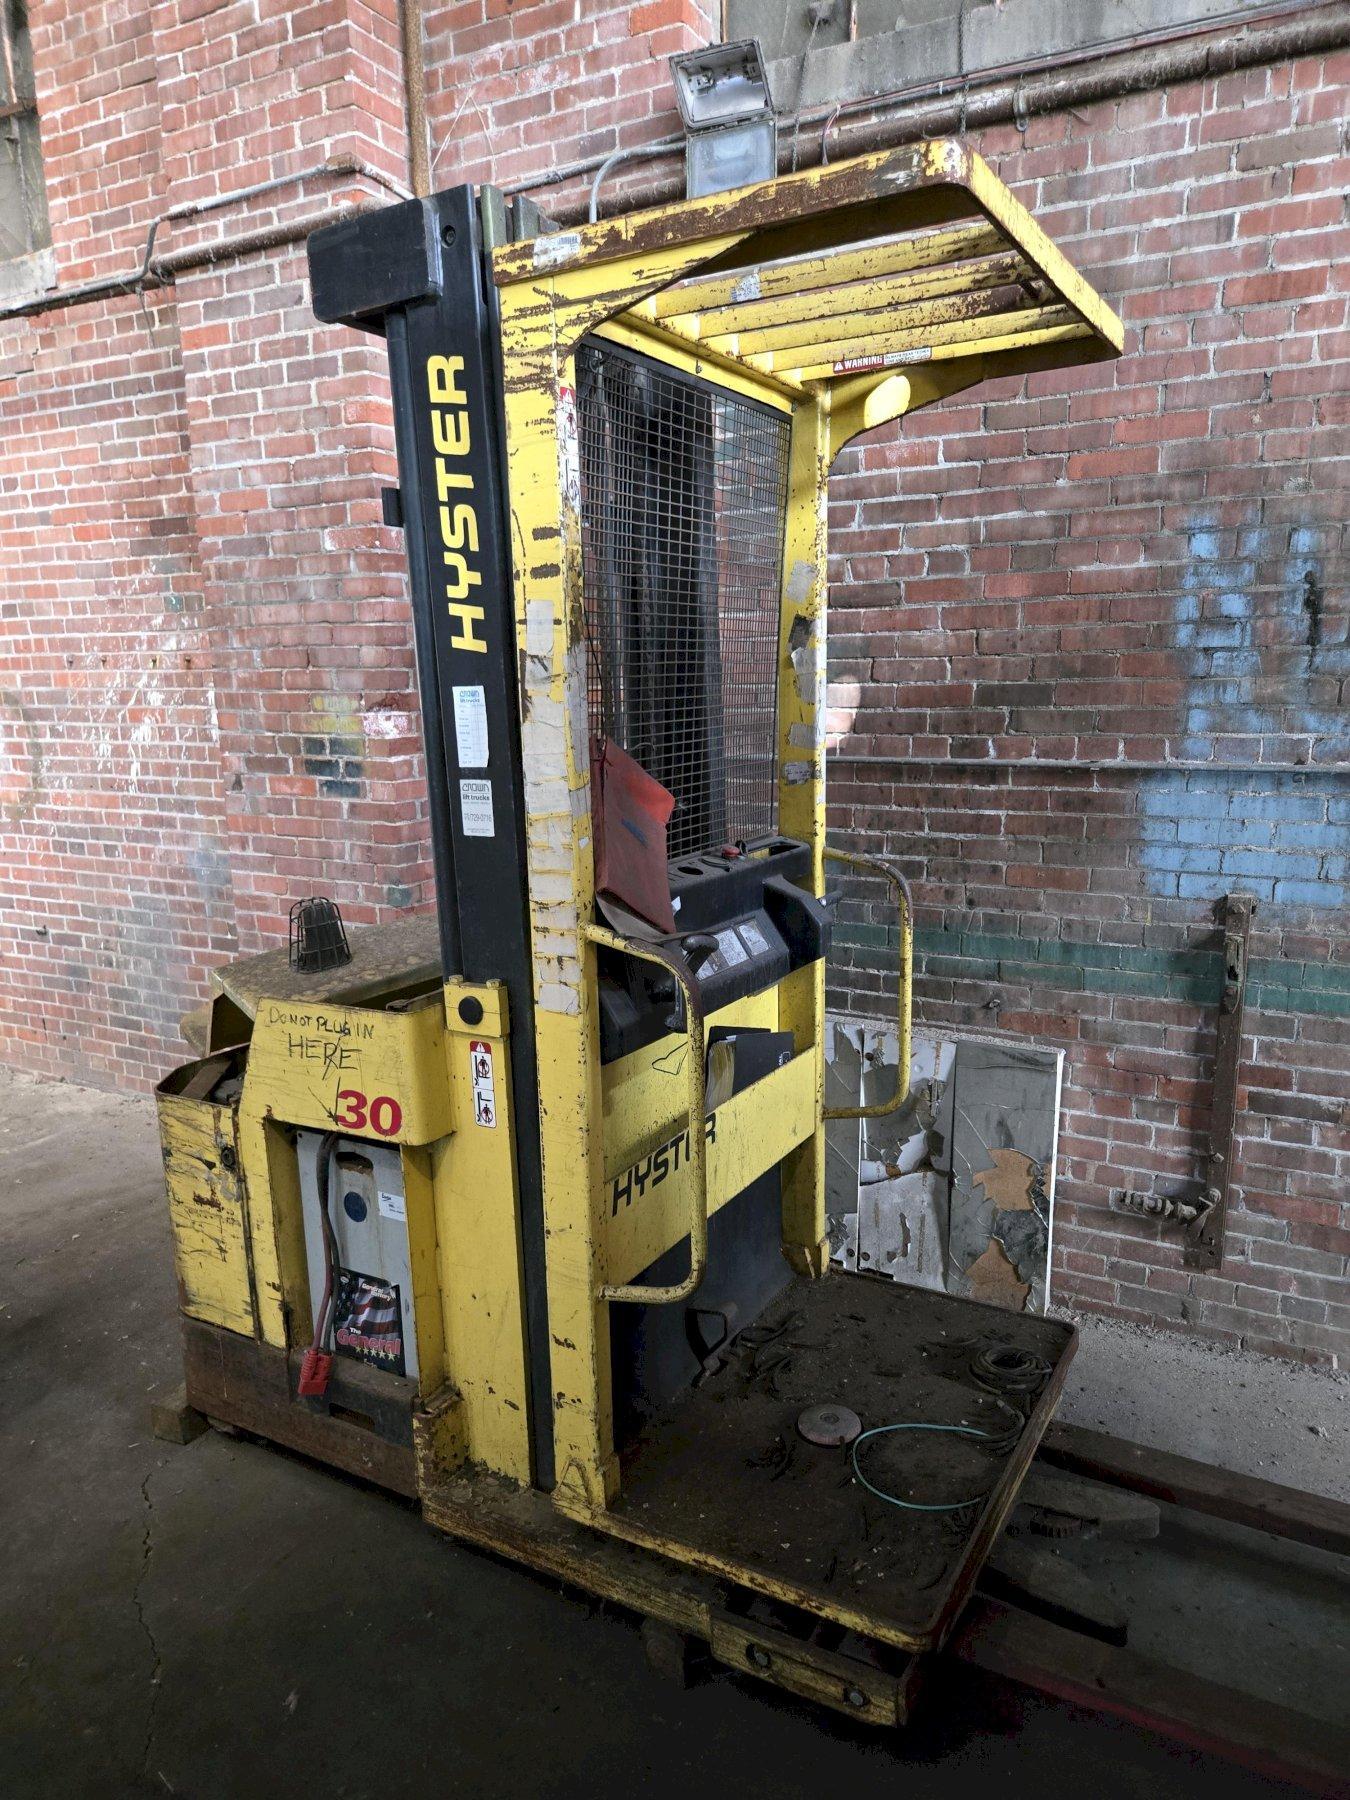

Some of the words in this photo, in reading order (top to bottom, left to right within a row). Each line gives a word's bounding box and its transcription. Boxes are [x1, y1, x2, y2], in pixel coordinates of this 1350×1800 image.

[844, 355, 883, 370] WARNING
[426, 355, 488, 654] HYSTER
[290, 1014, 312, 1027] NOT
[316, 1016, 351, 1037] PLUG
[357, 1023, 375, 1039] IN
[288, 1033, 362, 1070] HERE
[336, 1089, 402, 1137] 30
[611, 1112, 716, 1217] HYSTR
[337, 1328, 401, 1355] General
[349, 1326, 362, 1335] The
